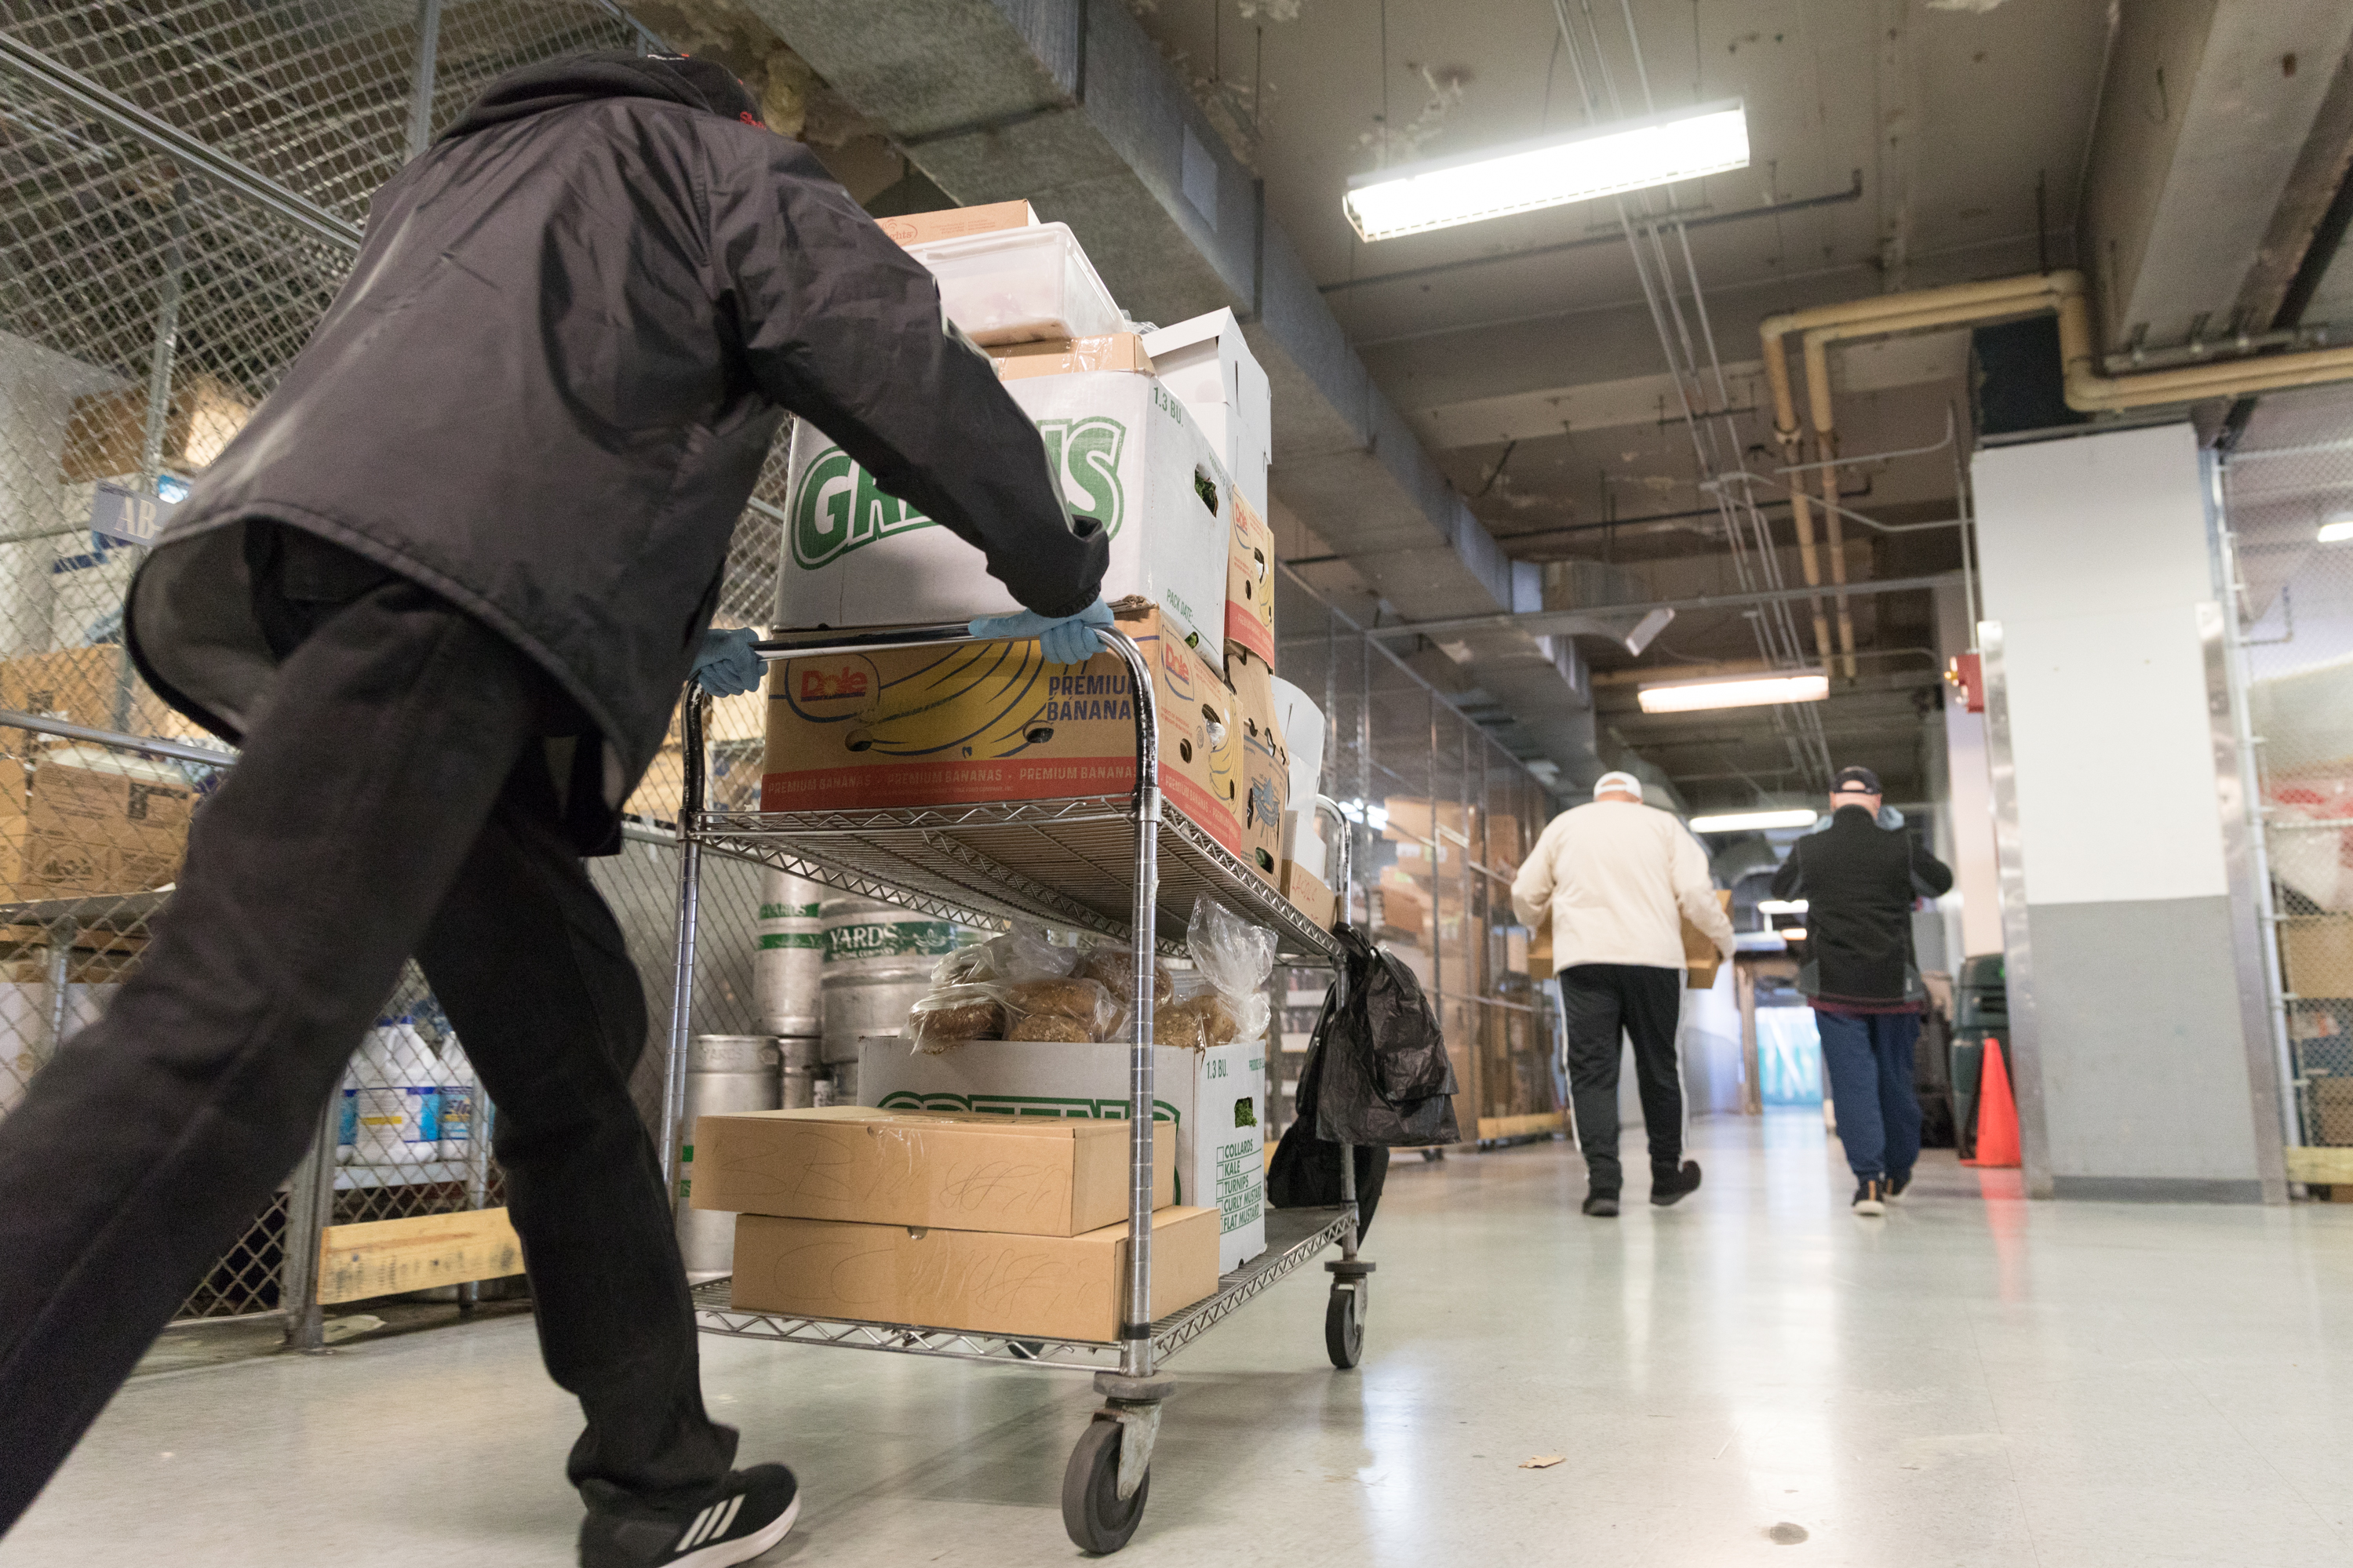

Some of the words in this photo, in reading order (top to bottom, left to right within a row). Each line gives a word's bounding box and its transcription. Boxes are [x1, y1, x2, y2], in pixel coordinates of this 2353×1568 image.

[1153, 387, 1167, 411] 1.3
[1171, 399, 1184, 427] BU.
[1236, 502, 1248, 532] Dole
[1167, 588, 1180, 612] PACK
[1180, 602, 1193, 624] DATE:
[1165, 642, 1189, 682] Dole
[800, 667, 868, 698] Dole
[1048, 675, 1133, 696] PREMIU
[1047, 700, 1131, 721] BANANA
[768, 778, 818, 794] PREMIUM
[945, 769, 1003, 784] BANANAS
[1020, 766, 1077, 780] PREMIUM
[1165, 774, 1189, 798] PREMIUM
[1189, 789, 1209, 813] BANANAS
[830, 924, 898, 951] YARDS
[1206, 1060, 1217, 1079] 1.3
[1218, 1059, 1229, 1077] BU.
[1225, 1138, 1253, 1159] COLLARDS
[1224, 1162, 1240, 1177] KALE
[1224, 1174, 1249, 1195] TURNIPS
[1224, 1193, 1243, 1213] CURLY
[1244, 1185, 1262, 1206] MUSTARD
[1223, 1217, 1238, 1231] FLAT
[1238, 1204, 1260, 1225] MUSTARD
